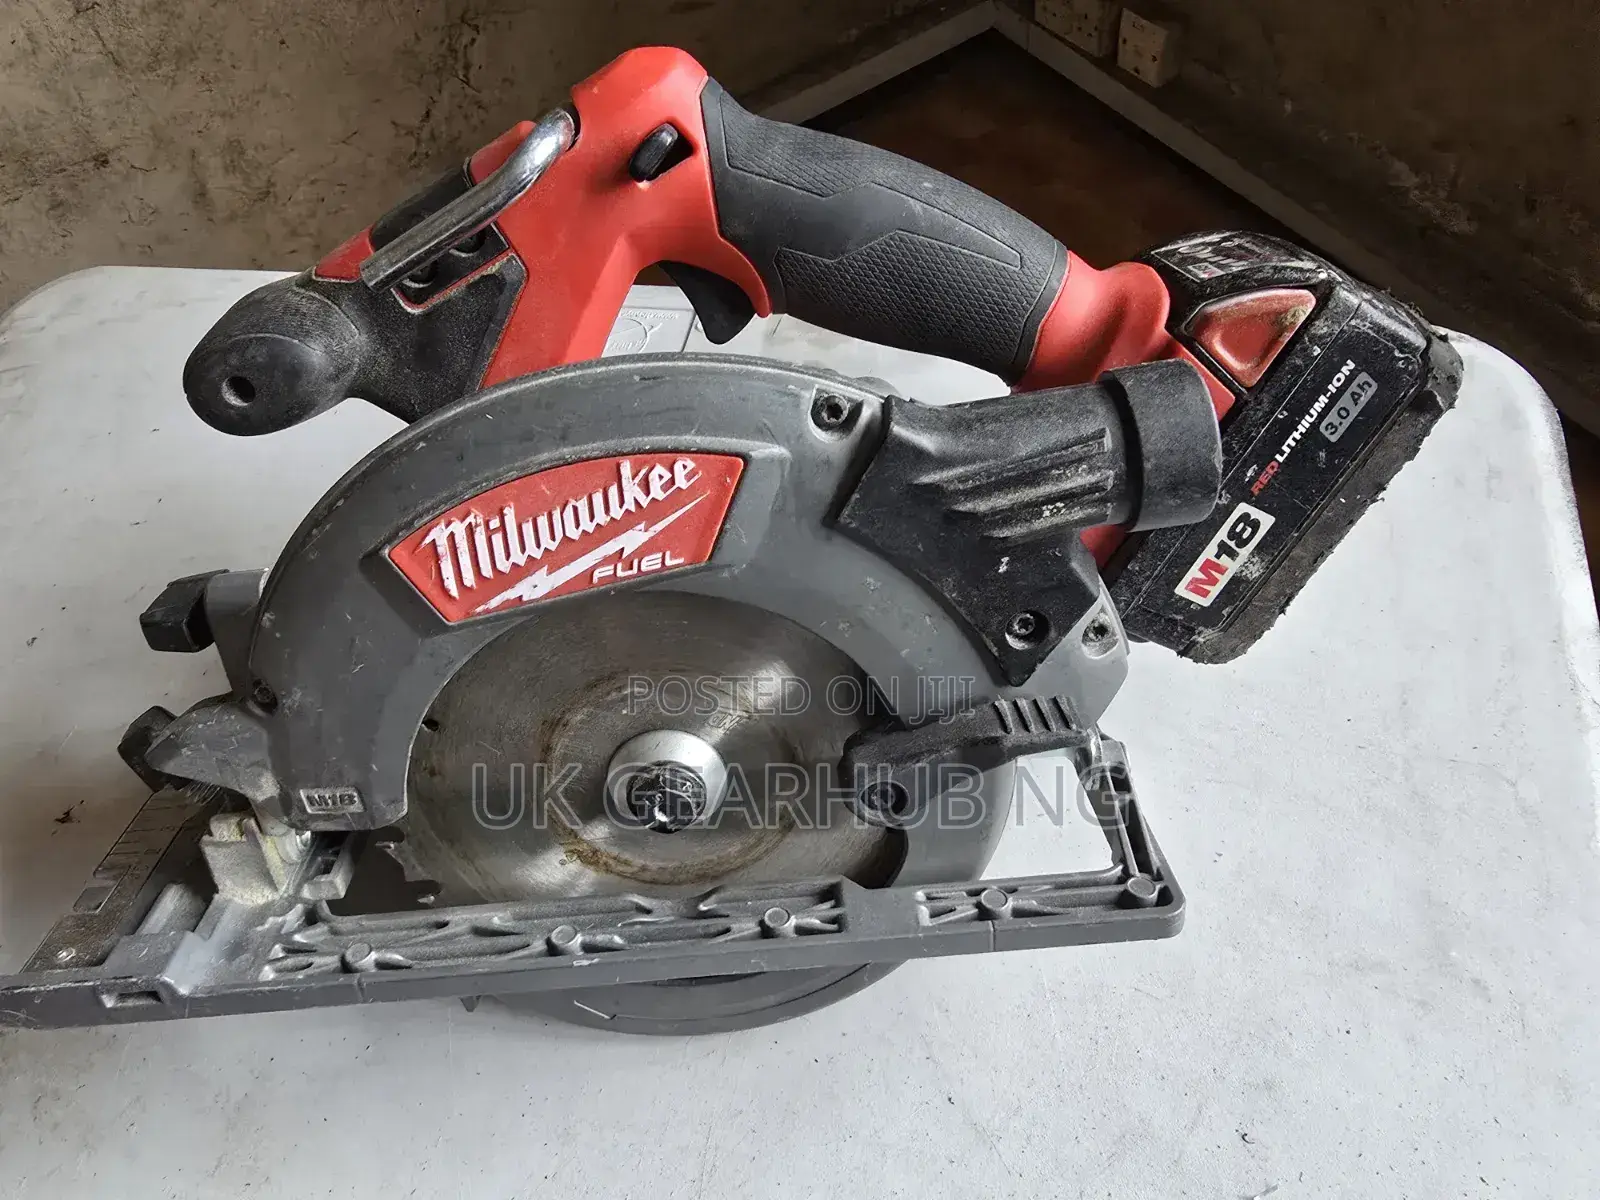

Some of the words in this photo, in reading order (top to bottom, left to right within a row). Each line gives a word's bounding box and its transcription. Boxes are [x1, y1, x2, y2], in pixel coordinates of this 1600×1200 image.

[1324, 405, 1350, 437] 3.0
[1351, 378, 1373, 407] Ah
[413, 457, 702, 600] Milwaukee
[1184, 511, 1262, 599] M18
[592, 550, 685, 584] FUEL
